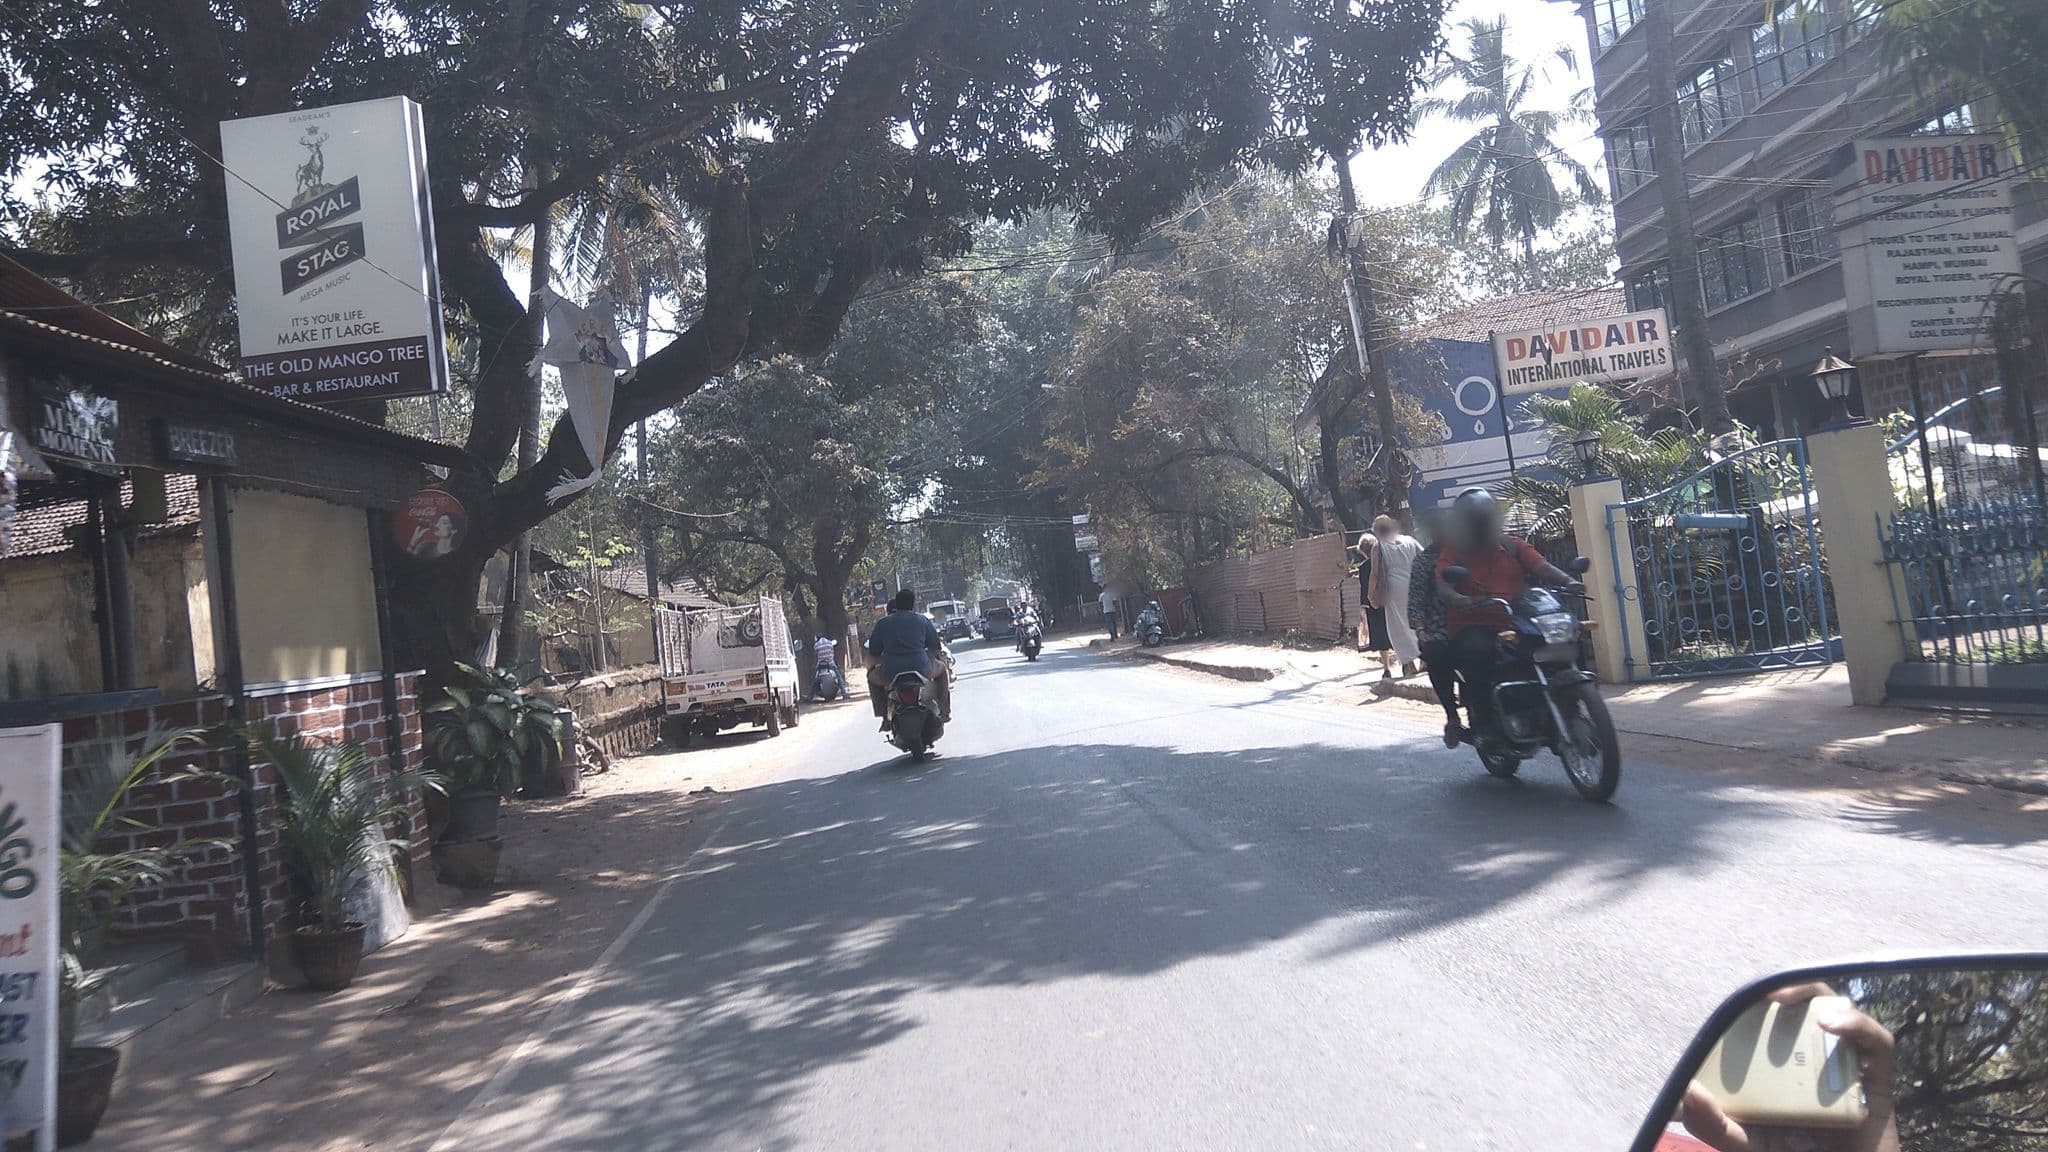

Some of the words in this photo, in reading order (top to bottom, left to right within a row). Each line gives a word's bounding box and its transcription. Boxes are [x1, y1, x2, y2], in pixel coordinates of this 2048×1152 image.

[1864, 143, 1999, 185] DAVIDAIR
[286, 194, 352, 236] ROYAL
[1873, 208, 1959, 221] NTERNATIONAL
[1908, 235, 1924, 244] TO
[1926, 233, 1948, 243] THE
[1950, 231, 1970, 241] TAJ
[297, 239, 350, 278] STAG
[299, 286, 323, 303] MEGA
[325, 272, 351, 291] MUSIC
[277, 328, 318, 346] MAKE
[321, 326, 333, 341] IT
[336, 321, 384, 338] LARGE.
[291, 313, 309, 327] IT'S
[310, 312, 341, 326] YOUR
[343, 310, 366, 322] LIFE.
[1506, 318, 1659, 361] DAVIDAIR
[244, 361, 275, 380] THE
[279, 355, 313, 375] OLD
[317, 349, 384, 370] MANGO
[388, 344, 425, 361] TREE
[1507, 356, 1607, 386] INTERNATIONAL
[1609, 347, 1667, 372] TRAVELS
[273, 383, 299, 398] BAR
[302, 382, 312, 394] &
[316, 371, 400, 393] RESTAURANT
[706, 681, 726, 689] TATA
